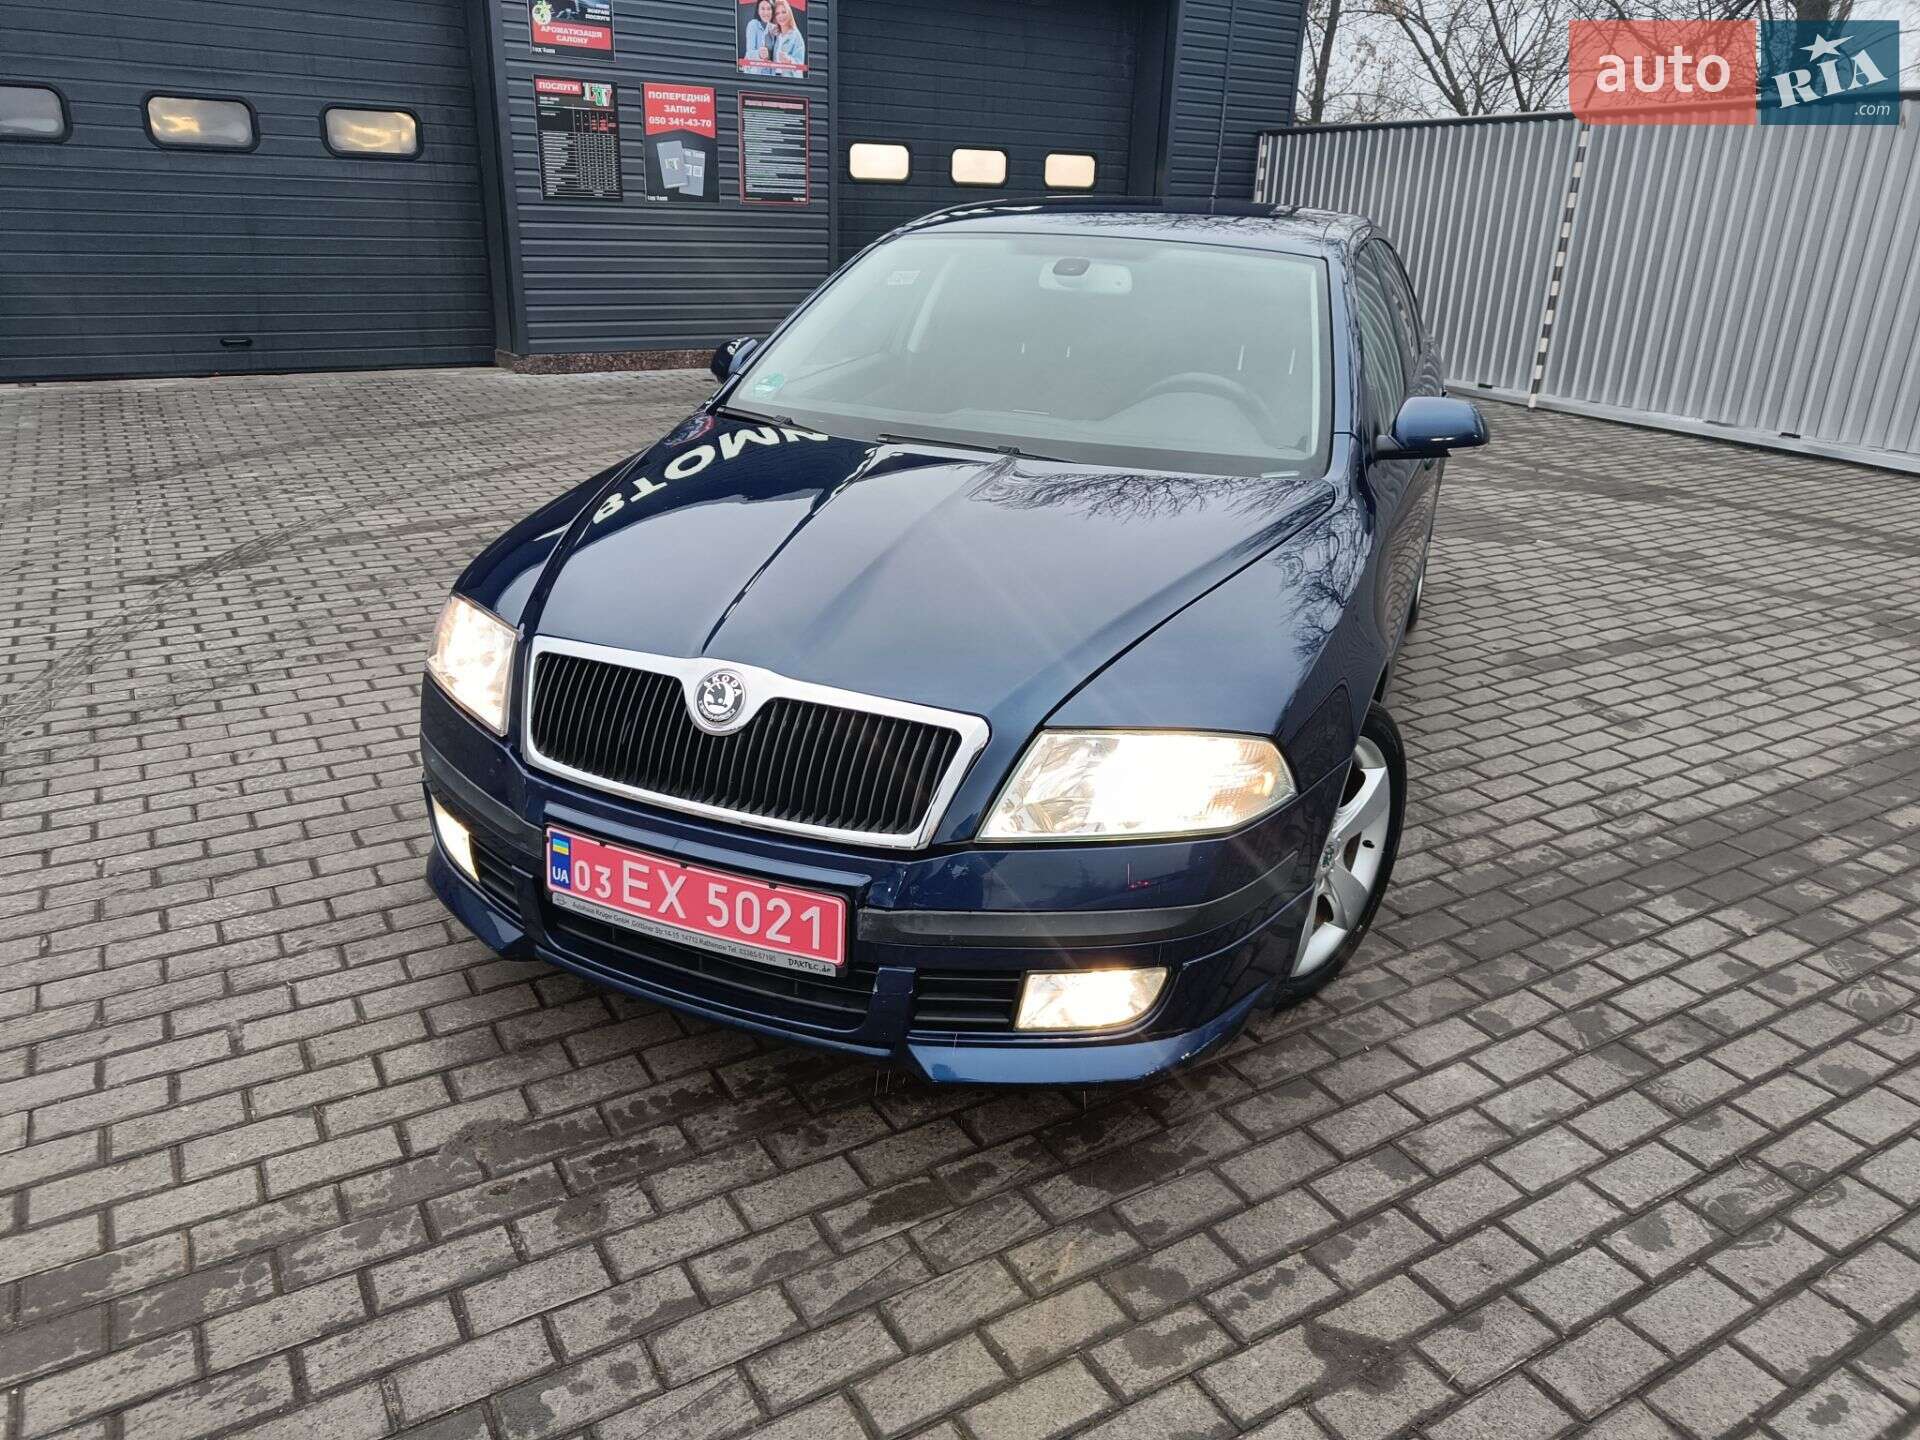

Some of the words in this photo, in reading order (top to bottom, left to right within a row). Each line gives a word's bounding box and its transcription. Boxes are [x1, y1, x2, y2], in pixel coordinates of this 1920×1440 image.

[556, 35, 588, 44] САЛОНУ
[538, 81, 579, 92] ПОСЛУГИ
[648, 90, 711, 103] ПОПЕРЕДНІЙ
[663, 104, 697, 115] ЗАПИС
[648, 116, 666, 126] 050
[668, 117, 712, 128] 341-43-70
[552, 867, 569, 885] UA
[706, 882, 822, 950] 5021
